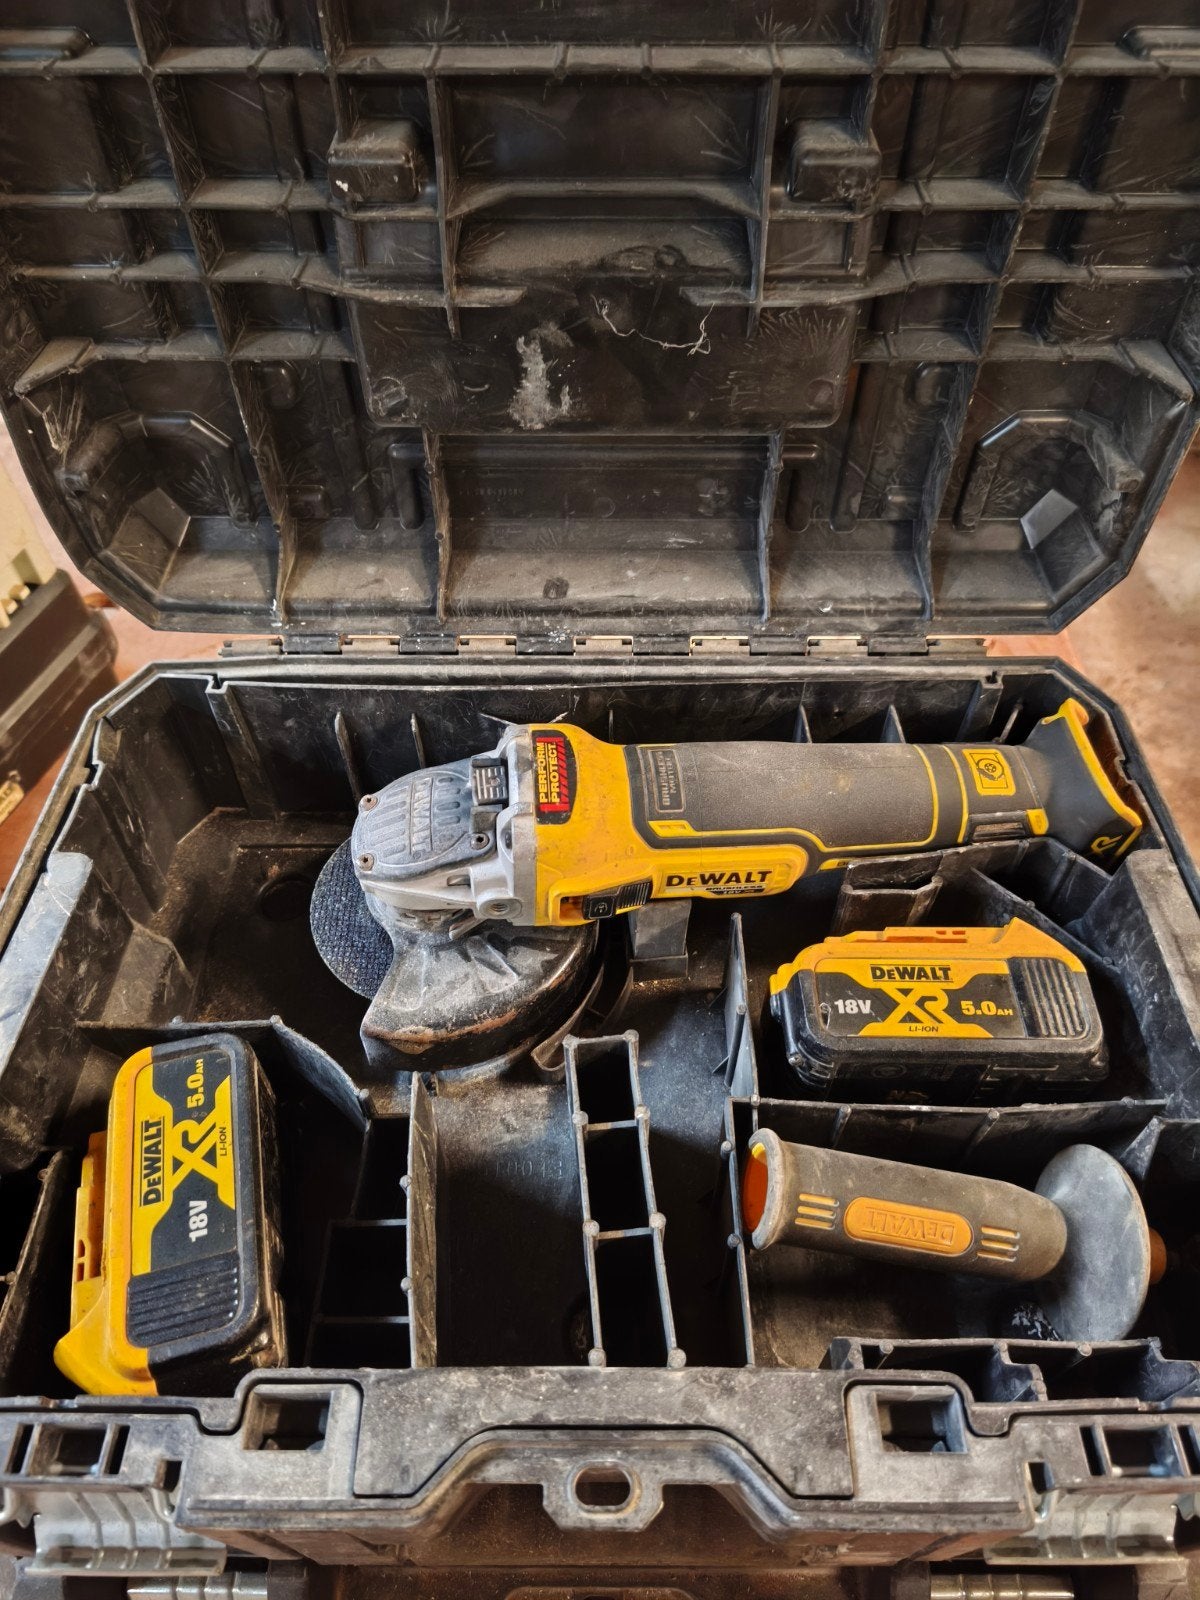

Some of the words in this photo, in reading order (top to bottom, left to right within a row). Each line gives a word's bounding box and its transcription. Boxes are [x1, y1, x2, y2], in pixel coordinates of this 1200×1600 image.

[536, 742, 548, 803] PERFORM
[548, 743, 560, 803] PROTECT
[665, 871, 772, 887] DEWALT
[870, 966, 951, 980] DEWALT
[834, 999, 872, 1015] 18V
[881, 987, 959, 1023] XR
[908, 1025, 939, 1033] LI-ION
[172, 1119, 217, 1191] XR
[219, 1126, 227, 1157] LI-ION
[143, 1119, 163, 1207] DEWALT
[188, 1200, 208, 1243] 18V
